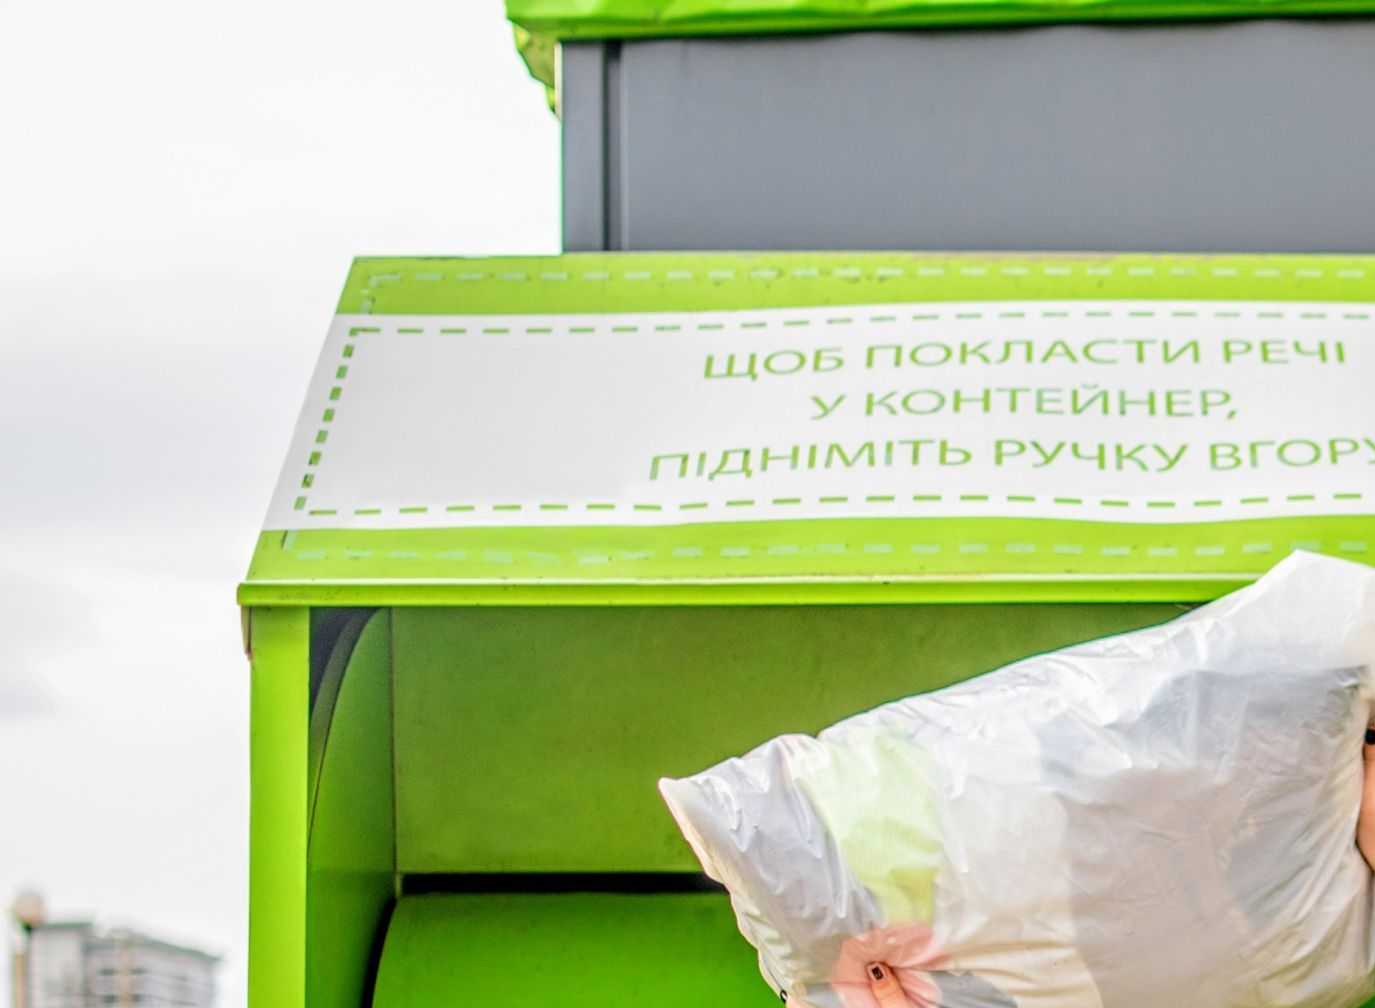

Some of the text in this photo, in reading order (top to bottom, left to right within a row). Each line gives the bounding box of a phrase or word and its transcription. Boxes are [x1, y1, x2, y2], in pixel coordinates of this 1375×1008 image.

[704, 338, 1346, 380] ЩОБ ПОКЛАСТИ РЕЧІ
[811, 384, 1239, 421] У КОНТЕЙНЕР,
[650, 439, 973, 481] ПІДНІМІТЬ
[994, 438, 1189, 472] РУЧКУ
